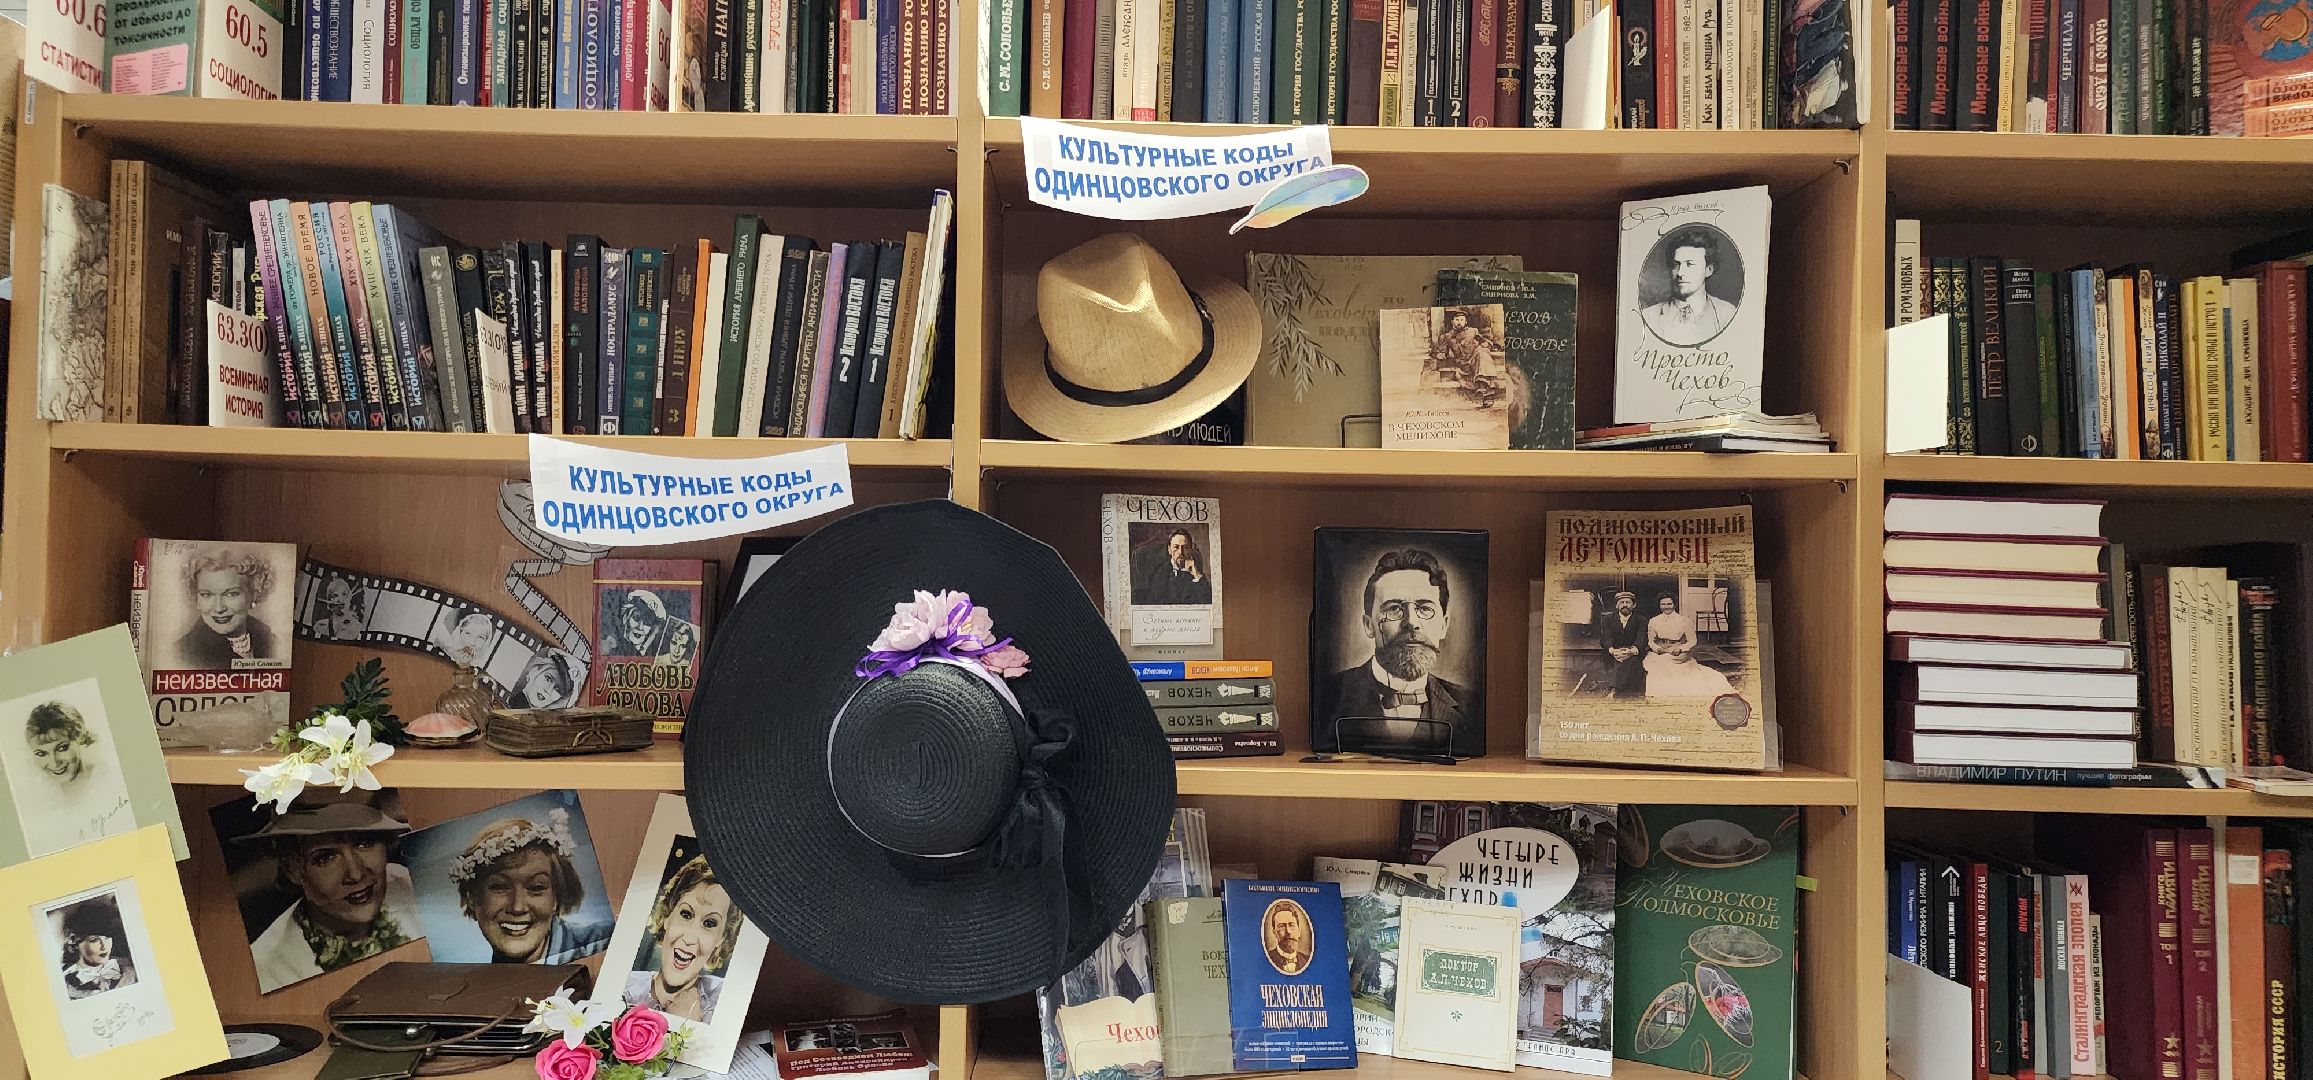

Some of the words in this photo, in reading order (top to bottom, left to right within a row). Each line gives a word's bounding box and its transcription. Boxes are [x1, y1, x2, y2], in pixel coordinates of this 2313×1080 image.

[226, 5, 267, 58] 60.5
[410, 17, 421, 49] ОБЩАЯ
[1295, 12, 1304, 71] ГОСУДАРСТВА
[1328, 17, 1338, 73] ГОСУДАРСТВА
[2062, 11, 2074, 80] ЧЕРЧИЛЛЬ
[362, 20, 374, 90] Социология
[497, 30, 506, 85] ЗАПАДНАЯ
[903, 20, 914, 109] ПОЗНАНИЮ
[919, 19, 929, 108] ПОЗНАНИЮ
[936, 22, 947, 110] ПОЗНАНИЮ
[1293, 75, 1302, 115] ИСТОРИЯ
[1327, 76, 1335, 115] ИСТОРИЯ
[1894, 46, 1910, 114] Мировые
[1929, 46, 1949, 114] Мировые
[1970, 46, 1991, 114] Мировые
[1451, 101, 1460, 116] 2
[1059, 135, 1216, 168] КУЛЬТУРНЫЕ
[1224, 143, 1293, 165] КОДЫ
[1034, 168, 1230, 202] ОДИНЦОВСКОГО
[1238, 155, 1325, 187] ОКРУГА
[298, 214, 312, 250] ВРЕМЯ
[312, 212, 326, 255] РОССИЯ
[339, 214, 350, 242] ВЕКА
[357, 216, 369, 243] ВЕКА
[739, 234, 748, 258] РИМА
[306, 256, 319, 296] НОВОЕ
[345, 248, 357, 287] XIX-XX
[364, 249, 379, 298] XVIII-XIX
[734, 262, 745, 302] ДРЕВНЕГО
[1900, 256, 1913, 313] РОМАНОВЫХ
[807, 270, 822, 328] АНТИЧНОСТИ
[1481, 291, 1519, 299] СМИРНОВА
[1981, 266, 2000, 344] ВЕЛИКИЙ
[217, 312, 269, 356] 63.3(0)
[607, 284, 617, 356] НОСТРАДАМУС
[729, 304, 741, 343] ИСТОРИЯ
[801, 330, 814, 371] ПОРТРЕТЫ
[1634, 349, 1729, 380] Просто
[2157, 322, 2169, 369] НИКОЛАЙ
[220, 365, 268, 394] ВСЕМИРНАЯ
[284, 351, 297, 401] ИСТОРИЯ
[304, 351, 318, 401] ИСТОРИЯ
[325, 353, 339, 402] ИСТОРИЯ
[342, 352, 357, 401] ИСТОРИЯ
[365, 354, 380, 403] ИСТОРИЯ
[385, 355, 400, 404] ИСТОРИЯ
[407, 357, 422, 405] ИСТОРИЯ
[839, 356, 850, 382] 2
[1659, 364, 1733, 391] Чехов
[1987, 353, 2004, 399] ПЕТР
[226, 394, 263, 419] ИСТОРИЯ
[515, 385, 527, 415] ТАЙНЫ
[535, 385, 547, 417] ТАЙНЫ
[792, 374, 808, 436] ВЫДАЮЩИЕСЯ
[1188, 421, 1232, 444] ЛЮДЕЙ
[1388, 424, 1395, 432] В
[1397, 420, 1464, 431] ЧЕХОВСКОМ
[1396, 431, 1458, 441] МЕЛИХОВЕ
[568, 465, 733, 496] КУЛЬТУРНЫЕ
[741, 469, 813, 492] КОДЫ
[542, 500, 748, 534] ОДИНЦОВСКОГО
[755, 481, 845, 514] ОКРУГА
[1103, 500, 1113, 543] ЧЕХОВ
[1127, 499, 1208, 521] ЧЕХОВ
[1560, 513, 1746, 536] ПОДМОСКОВНЫЙ
[1560, 537, 1711, 566] ЛЕТОПИСЕЦ
[157, 673, 282, 690] неизвестная
[596, 663, 694, 694] ЛЮБОВЬ
[1168, 687, 1212, 698] ЧЕХОВ
[607, 690, 686, 717] ОРЛОВА
[1168, 715, 1213, 726] ЧЕХОВ
[1560, 721, 1575, 729] 150
[1569, 732, 1585, 740] дня
[1587, 732, 1630, 741] рождения
[1651, 734, 1681, 743] Чехова
[1916, 766, 2006, 780] ВЛАДИМИР
[2014, 767, 2067, 782] ПУТИН
[2107, 773, 2152, 782] фотографии
[1478, 838, 1560, 865] ЧЕТЫРЕ
[1459, 862, 1533, 888] ЖИЗНИ
[1661, 869, 1779, 912] ЧЕХОВСКОЕ
[1919, 868, 1927, 898] ИТАЛИИ
[1977, 876, 1986, 911] ПОБЕДЫ
[2163, 861, 2176, 918] ПАМЯТИ
[1621, 879, 1781, 930] ПОДМОСКОВЬЕ
[1978, 914, 1987, 937] ЛИЦО
[2070, 901, 2084, 950] эпопея
[2091, 925, 2099, 964] БЛОКАДЫ
[1440, 958, 1479, 973] ДОКТОР
[1978, 941, 1988, 982] ЖЕНСКОЕ
[2057, 945, 2066, 970] МОСКВА
[2092, 966, 2100, 977] ИЗ
[1260, 984, 1324, 1008] ЧЕХОВСКАЯ
[1430, 973, 1487, 990] А.П.ЧЕХОВ
[2092, 980, 2102, 1021] РЕПОРТАЖ
[2270, 979, 2284, 1014] СССР
[1261, 1010, 1328, 1031] ЭНЦИКЛОПЕДИЯ
[2072, 954, 2089, 1062] Сталинградская
[1995, 1040, 2003, 1053] 2
[2271, 1019, 2285, 1080] ИСТОРИЯ
